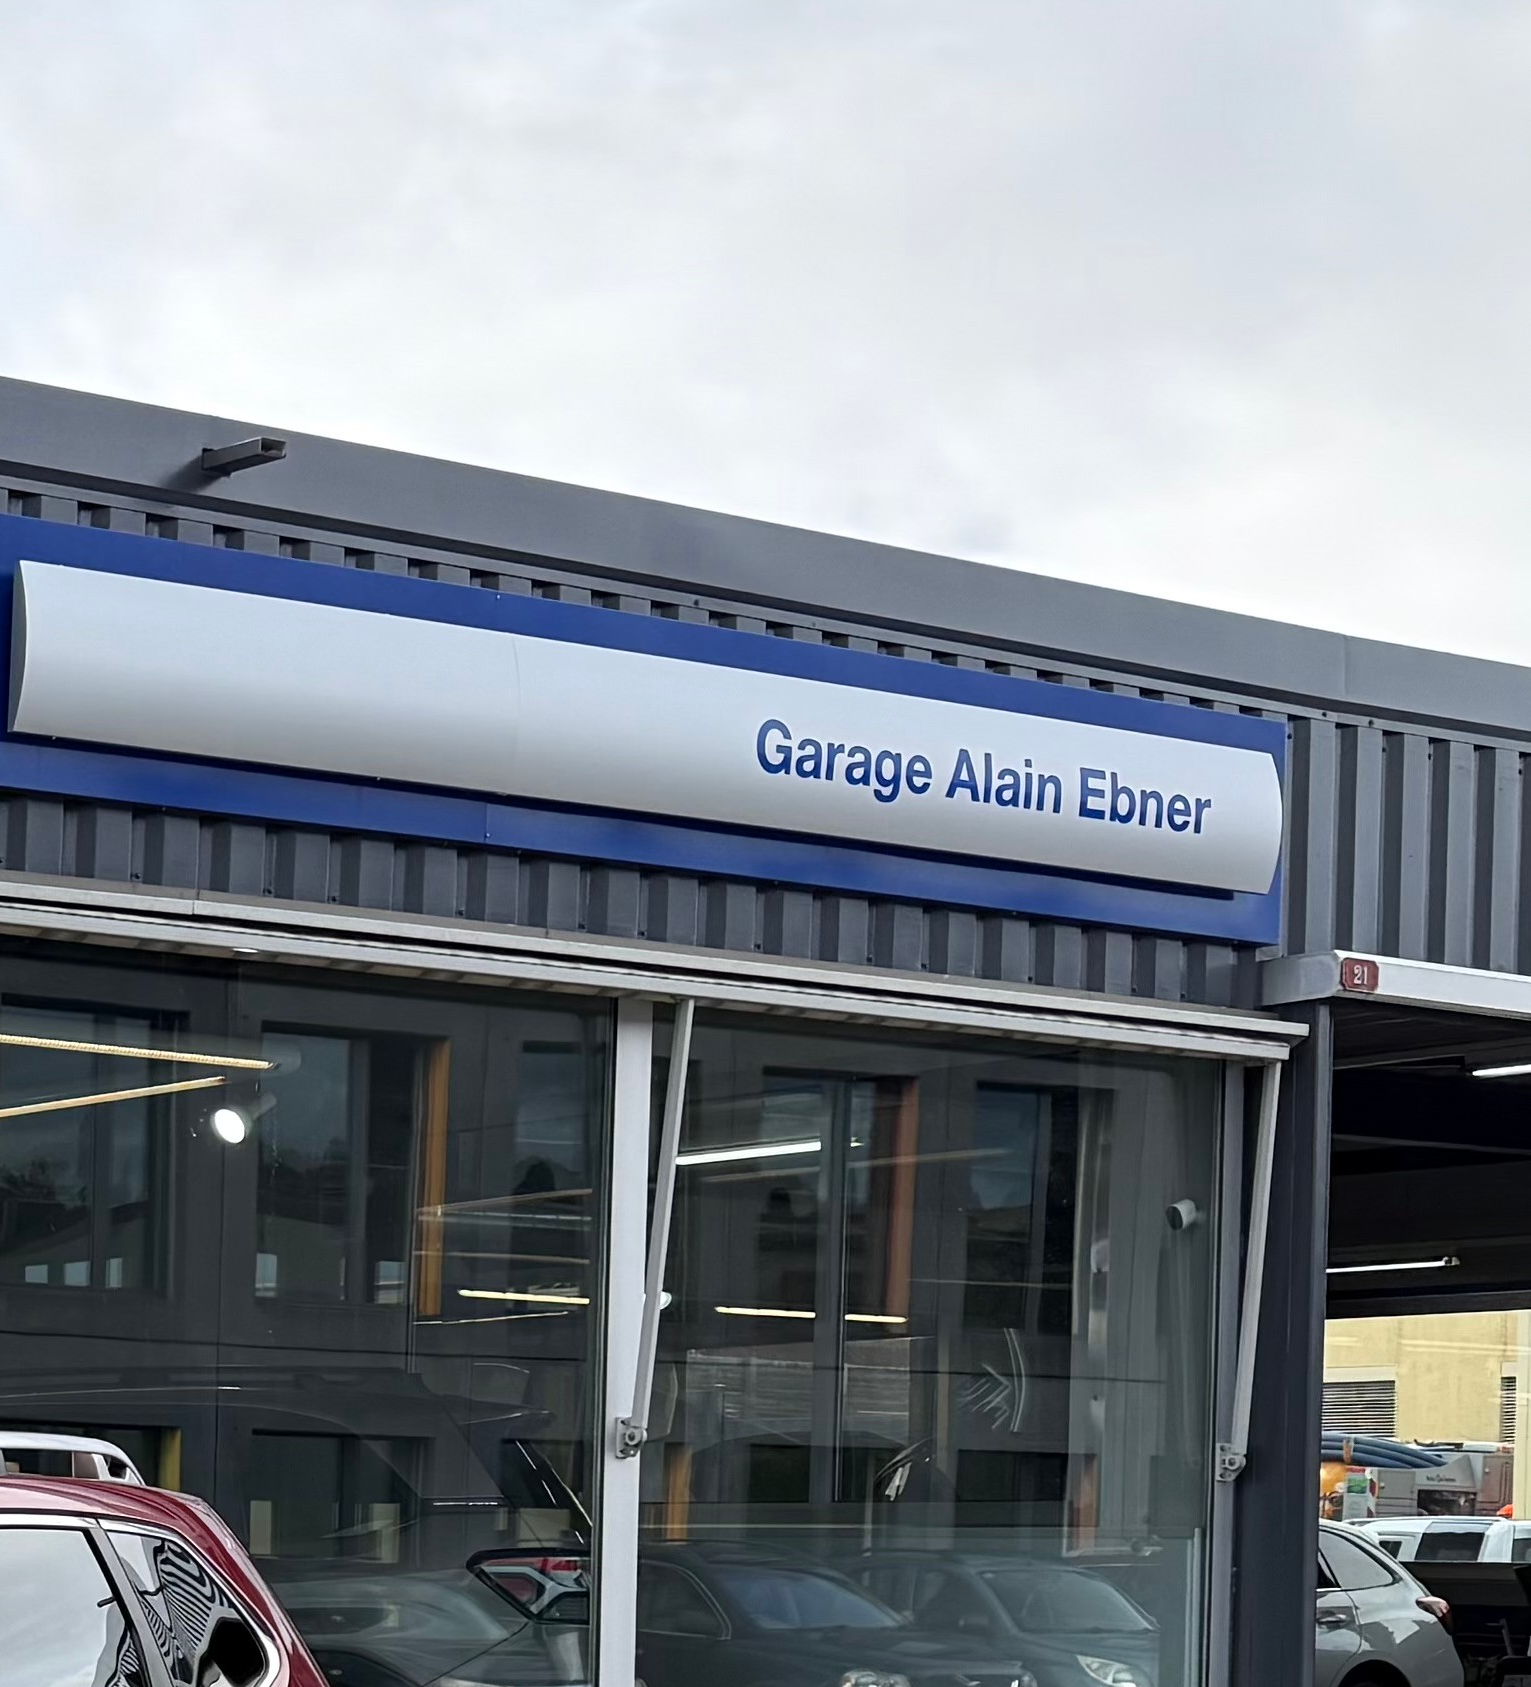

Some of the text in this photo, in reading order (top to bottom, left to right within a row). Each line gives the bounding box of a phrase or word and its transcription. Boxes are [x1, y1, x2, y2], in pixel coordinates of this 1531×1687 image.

[756, 718, 1212, 834] Garage Alain Ebner
[1353, 965, 1368, 985] 21
